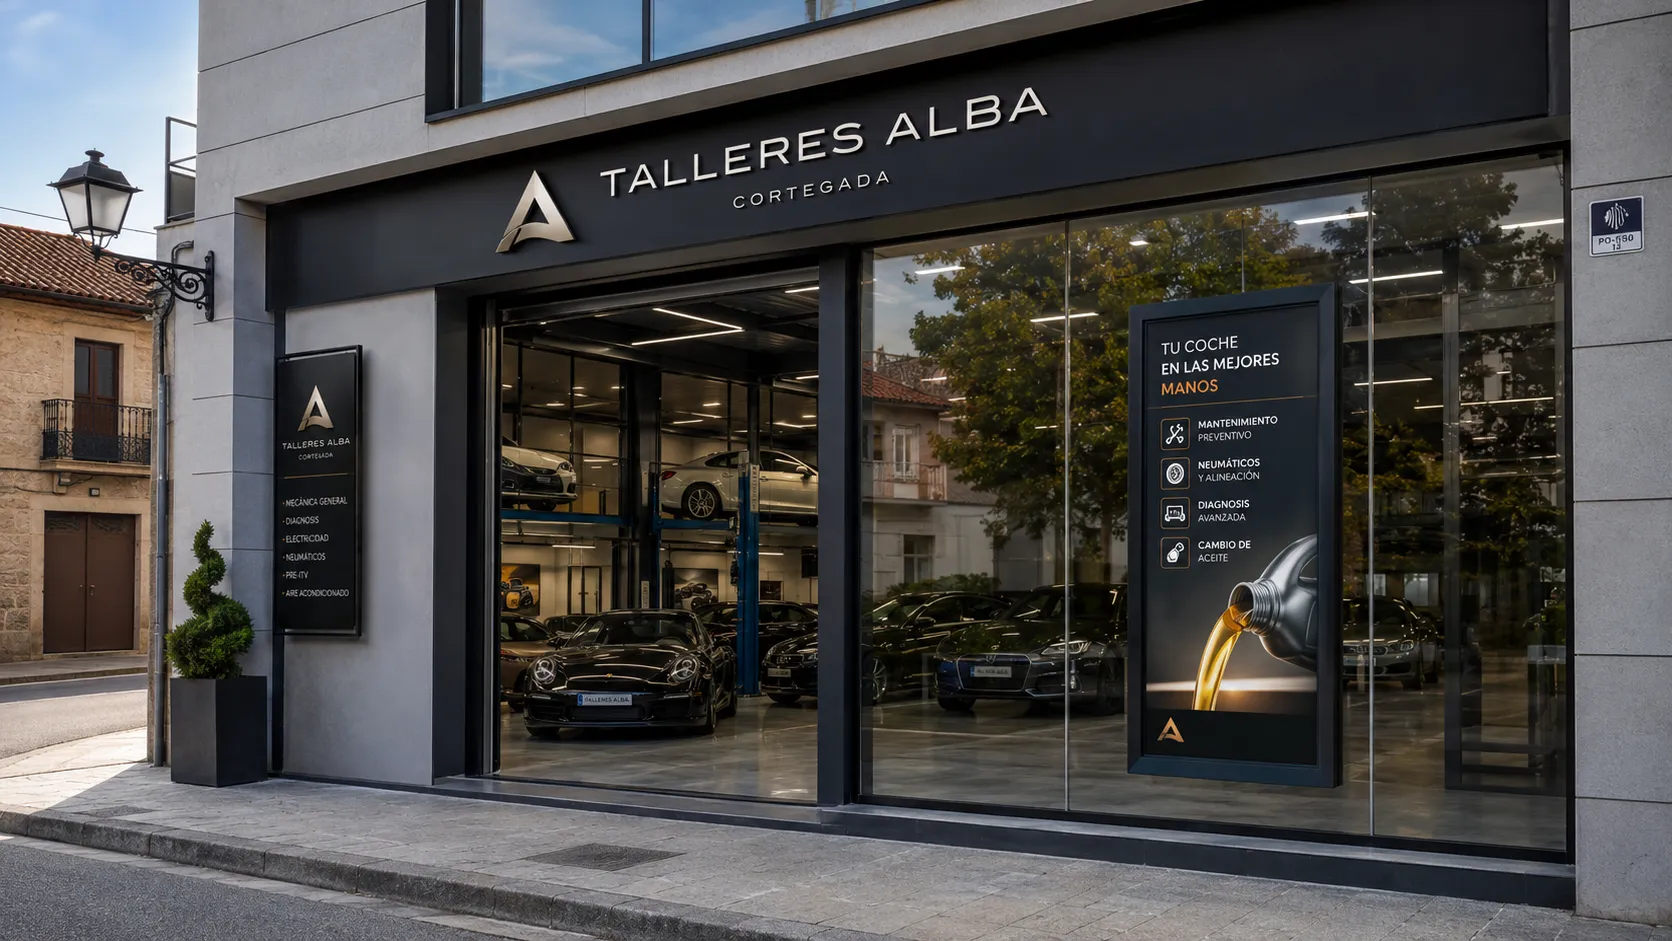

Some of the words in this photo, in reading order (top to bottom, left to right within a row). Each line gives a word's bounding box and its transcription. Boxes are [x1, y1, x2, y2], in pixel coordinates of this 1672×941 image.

[600, 122, 864, 198] TALLERES
[885, 87, 1048, 146] ALBA
[732, 170, 890, 209] CORTEGADA
[1161, 342, 1180, 355] TU
[1184, 335, 1239, 353] COCHE
[1161, 362, 1180, 376] EN
[1184, 359, 1210, 374] LAS
[1213, 352, 1280, 371] MEJORES
[1161, 378, 1219, 396] MANOS
[1198, 415, 1279, 429] MANTENIMIENTO
[1198, 430, 1252, 442] PREVENTIVO
[282, 439, 325, 450] TALLERES
[327, 437, 351, 446] ALBA
[1198, 457, 1261, 470] NEUMÁTICOS
[1198, 474, 1204, 483] Y
[1205, 470, 1260, 482] ALINEACIÓN
[1198, 499, 1250, 510] DIAGNOSIS
[1198, 512, 1247, 523] AVANZADA
[1198, 540, 1236, 550] CAMBIO
[1238, 540, 1251, 550] DE
[1198, 553, 1229, 563] ACEITE
